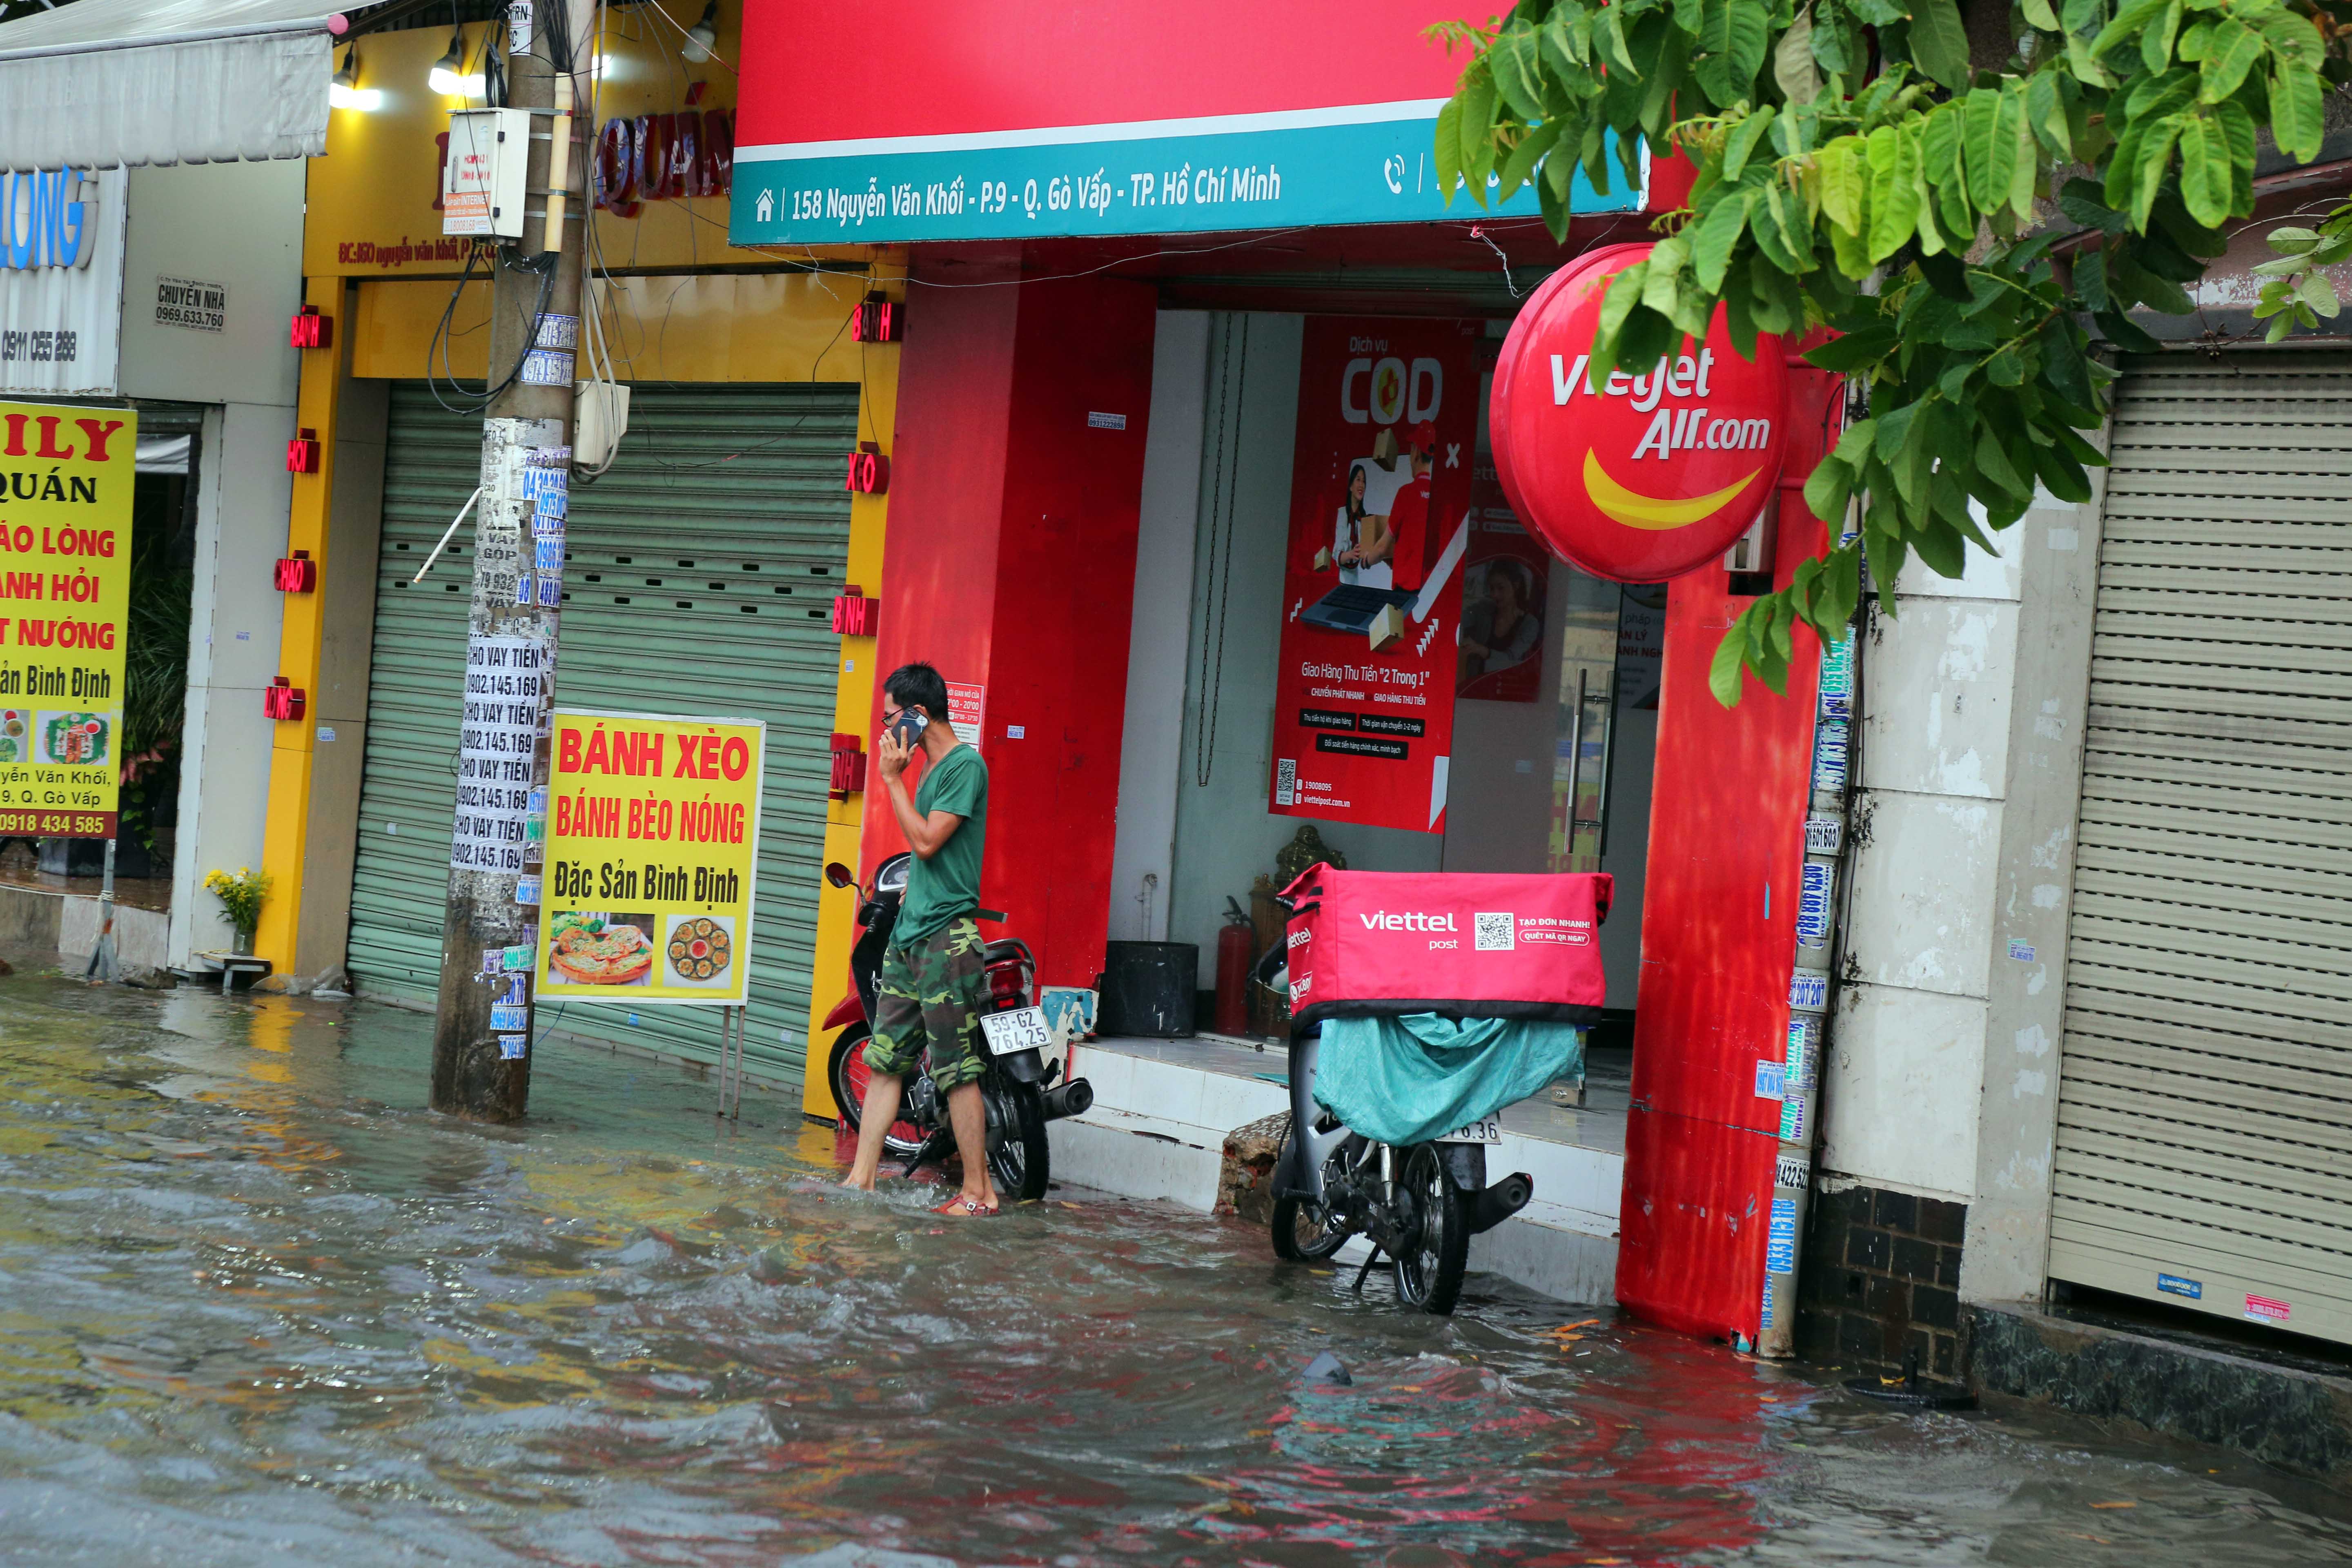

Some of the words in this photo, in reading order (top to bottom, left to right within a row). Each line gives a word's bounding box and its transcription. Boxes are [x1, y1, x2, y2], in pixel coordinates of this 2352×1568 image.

[461, 194, 490, 205] INTERNET
[793, 190, 822, 220] 158
[826, 177, 886, 227] Nguyễn
[890, 182, 922, 216] Văn
[925, 174, 964, 216] Khối
[980, 183, 1006, 213] P.9
[1023, 184, 1042, 220] Q.
[1047, 175, 1071, 209] Gò
[1077, 167, 1112, 217] Vấp
[1131, 173, 1156, 207] TP.
[1162, 163, 1189, 204] Hồ
[1194, 166, 1225, 202] Chí
[1231, 164, 1281, 202] Minh
[158, 281, 201, 307] CHUYỂN
[204, 287, 225, 311] NHÀ
[156, 306, 224, 327] 0969.633.760
[2, 331, 27, 361] 0911
[31, 331, 52, 361] 055
[55, 331, 77, 361] 288
[1350, 336, 1372, 355] Dịch
[1375, 339, 1388, 355] vụ
[1341, 357, 1443, 425] COD
[5, 414, 124, 461] ILY
[42, 523, 114, 557] LÒNG
[0, 572, 43, 599] NH
[52, 567, 99, 603] HỎI
[18, 616, 115, 650] NƯỚNG
[488, 648, 508, 666] VAY
[513, 642, 539, 668] TIỀN
[27, 665, 65, 696] Bình
[71, 667, 110, 704] Định
[1302, 662, 1319, 677] Giao
[1321, 664, 1342, 682] Hàng
[1344, 665, 1359, 680] Thu
[1361, 664, 1378, 682] Tiền
[1380, 668, 1389, 682] "2
[1392, 669, 1417, 689] Trong
[1419, 671, 1430, 686] 1"
[1346, 690, 1365, 700] NHANH
[1374, 693, 1385, 702] GIAO
[1387, 693, 1402, 704] HÀNG
[1403, 696, 1413, 704] THU
[483, 703, 503, 723] VAY
[508, 699, 534, 725] TIỀN
[559, 722, 664, 777] BÁNH
[673, 728, 749, 782] XÈO
[36, 770, 64, 783] Văn
[71, 770, 111, 787] Khối,
[479, 759, 499, 779] VAY
[503, 756, 530, 782] TIỀN
[2, 790, 15, 804] 9,
[22, 790, 37, 803] Q.
[44, 791, 65, 804] Gò
[71, 791, 100, 808] Vấp
[1305, 781, 1332, 791] 19008095
[1304, 795, 1350, 808] viettelpost.com.vn
[0, 814, 37, 831] 0918
[42, 815, 71, 832] 434
[75, 816, 105, 833] 585
[474, 817, 493, 837] VAY
[498, 815, 525, 841] TIỀN
[556, 787, 621, 839] BÁNH
[627, 790, 673, 842] BÈO
[679, 793, 745, 844] NÓNG
[555, 860, 593, 906] Đặc
[600, 859, 637, 900] Sản
[644, 864, 688, 902] Bình
[694, 866, 739, 911] Định
[1360, 909, 1458, 932] viettel
[1519, 918, 1536, 927] TẠO
[1539, 918, 1557, 926] ĐƠN
[1559, 919, 1591, 929] NHANH!
[1429, 939, 1459, 951] post
[1524, 931, 1544, 940] QUÉT
[991, 1011, 1036, 1033] 59-G2
[991, 1027, 1047, 1052] 764.25
